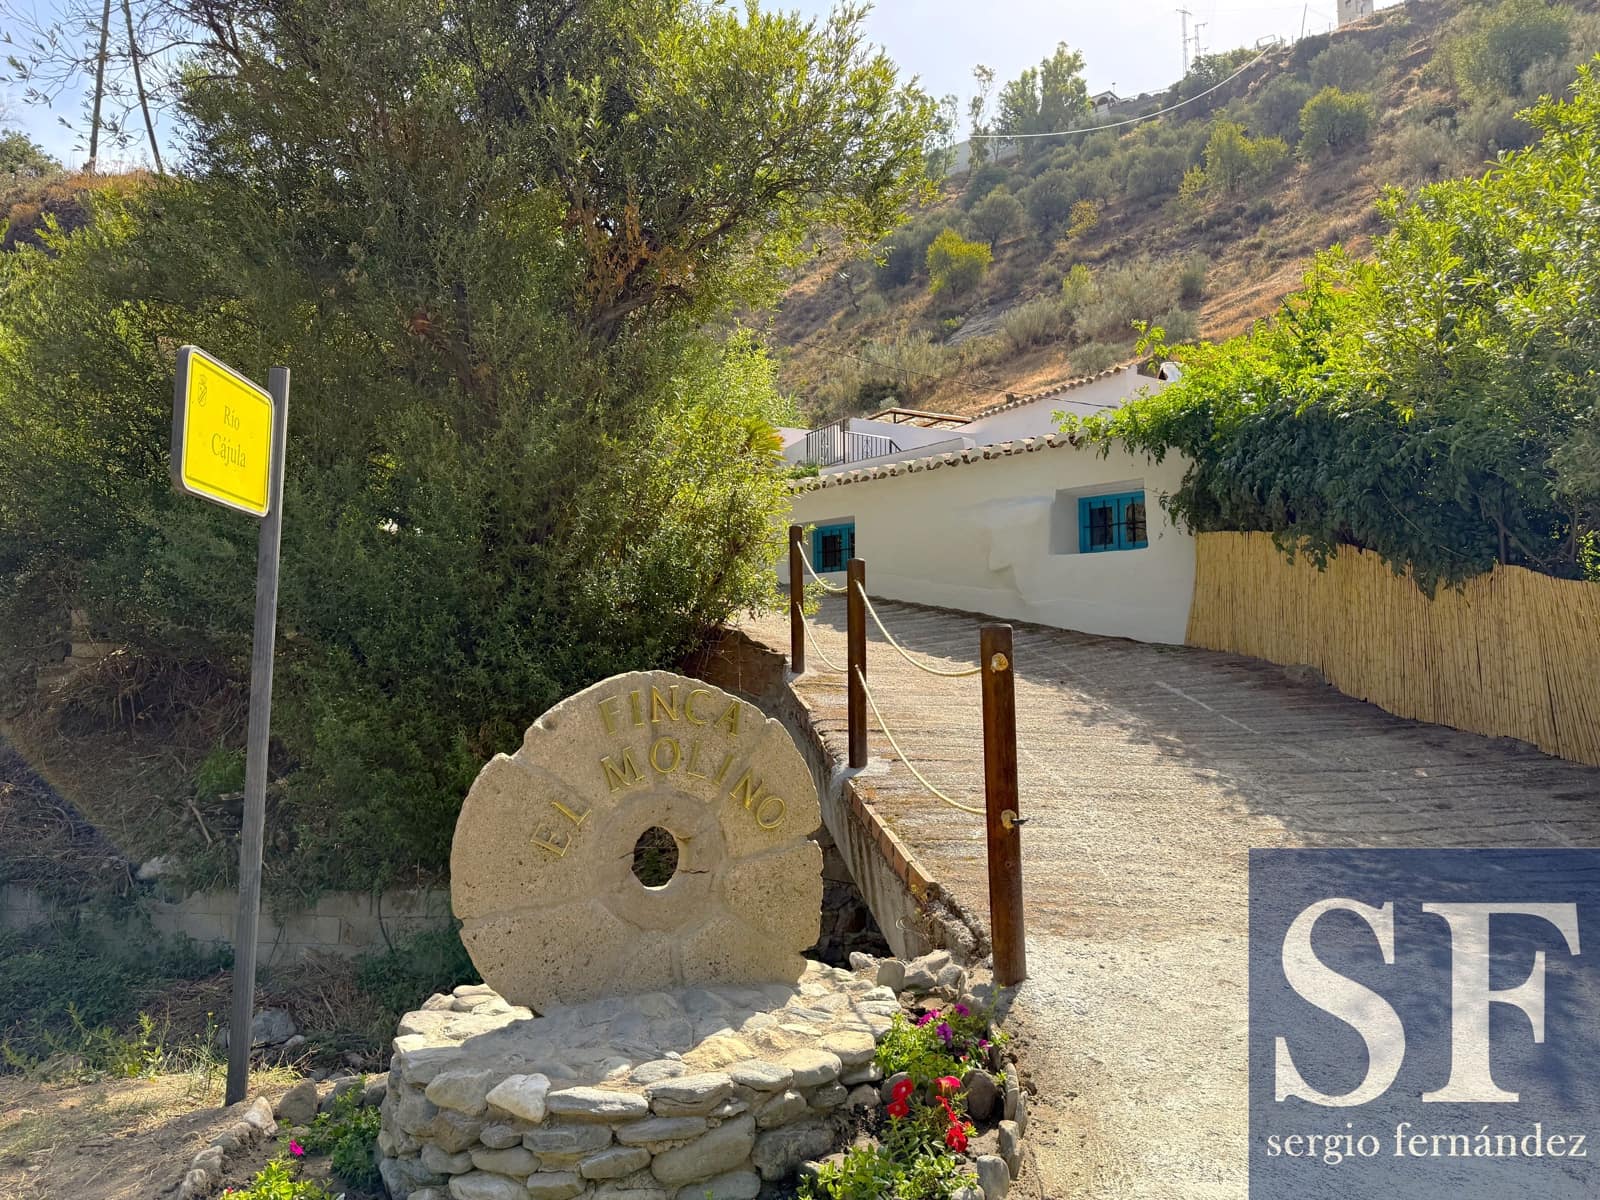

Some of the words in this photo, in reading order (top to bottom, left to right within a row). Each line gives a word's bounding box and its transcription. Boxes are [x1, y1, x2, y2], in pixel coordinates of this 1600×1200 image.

[598, 684, 742, 736] FINCA
[530, 800, 592, 857] EL
[600, 736, 787, 829] MOLINO
